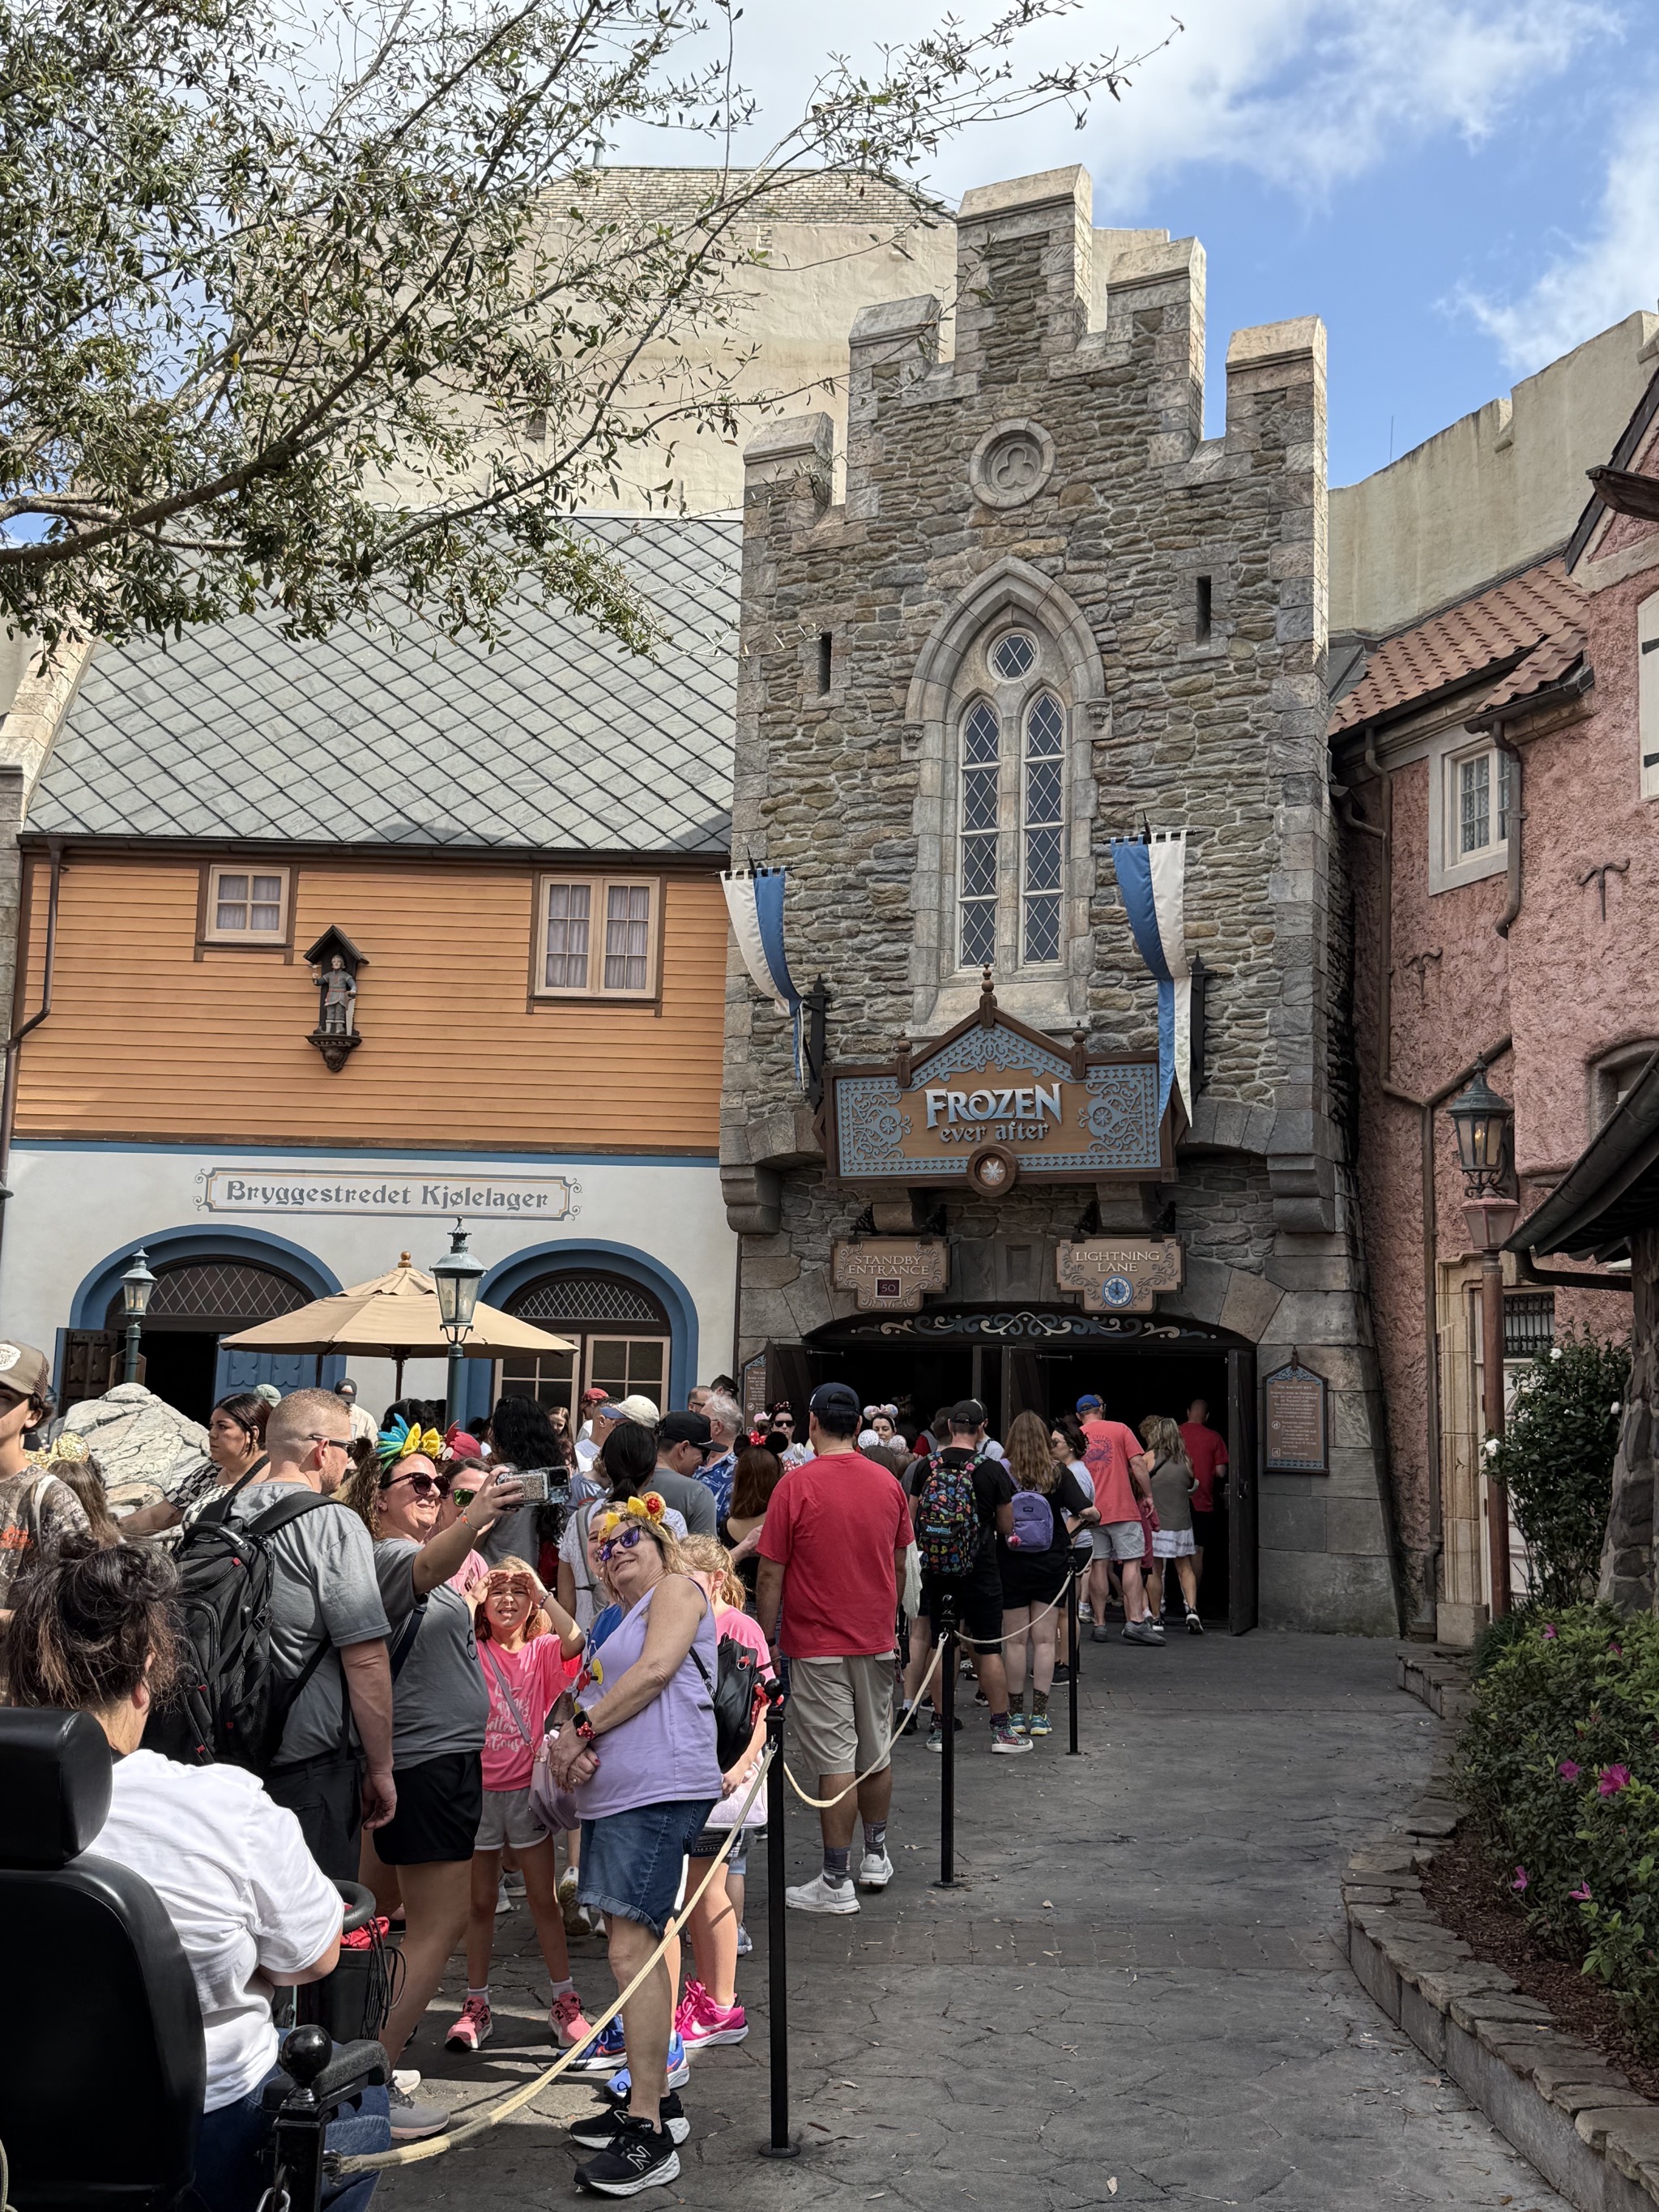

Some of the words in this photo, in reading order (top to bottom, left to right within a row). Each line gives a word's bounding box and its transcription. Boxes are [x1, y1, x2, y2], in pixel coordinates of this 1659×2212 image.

[924, 1083, 1062, 1129] FROZEN
[940, 1125, 987, 1143] ever
[995, 1121, 1049, 1142] after
[226, 1180, 411, 1205] Bryggestredet
[421, 1185, 549, 1211] Kjølelager
[854, 1255, 922, 1266] STANDBY
[1075, 1251, 1160, 1262] LIGHTNING
[848, 1264, 930, 1276] ENTRANCE
[1097, 1262, 1138, 1273] LANE
[881, 1283, 897, 1293] 50
